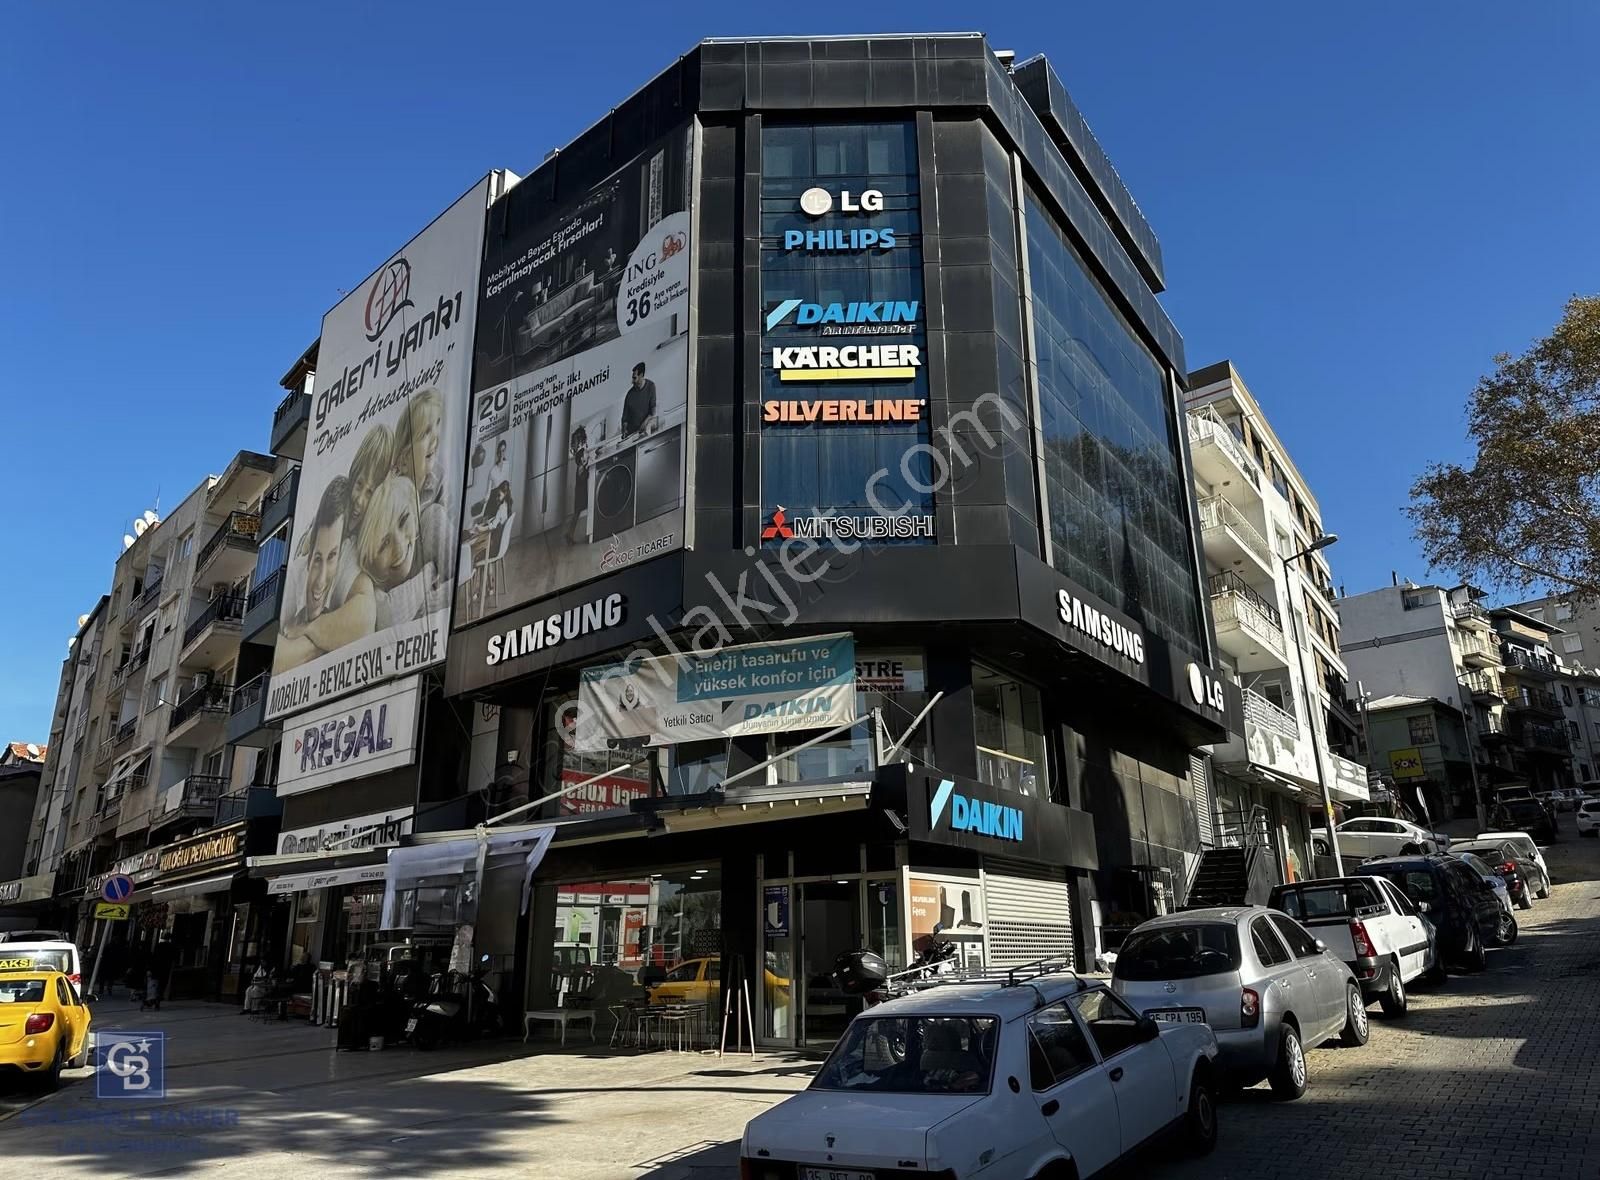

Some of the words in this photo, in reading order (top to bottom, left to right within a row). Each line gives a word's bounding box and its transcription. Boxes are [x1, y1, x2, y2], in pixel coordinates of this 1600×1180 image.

[841, 189, 884, 212] LG
[784, 227, 897, 250] PHILIPS
[486, 262, 517, 286] Mobilya
[517, 255, 527, 264] ve
[527, 239, 551, 259] Beyaz
[627, 252, 657, 284] ING
[626, 269, 665, 299] Kredisiyle
[625, 290, 651, 327] 36
[796, 301, 919, 325] DAIKIN
[772, 344, 922, 369] KÄRCHER
[480, 387, 509, 421] 20
[513, 389, 550, 414] Dünyada
[552, 380, 565, 394] bir
[566, 370, 581, 387] ilk!
[512, 416, 521, 428] 20
[536, 394, 565, 415] MOTOR
[763, 399, 920, 422] SILVERLINE
[793, 515, 936, 538] MITSUBISHI
[486, 593, 623, 666] SAMSUNG
[1058, 588, 1144, 664] SAMSUNG
[268, 676, 311, 715] MOBİLYA
[318, 658, 353, 697] BEYAZ
[354, 646, 383, 687] EŞYA
[395, 628, 439, 671] PERDE
[695, 656, 737, 674] Enerji
[741, 648, 807, 669] tasarufu
[811, 647, 830, 660] ve
[694, 675, 747, 696] yüksek
[751, 669, 803, 687] konfor
[808, 665, 837, 683] için
[1205, 674, 1225, 712] LG
[663, 715, 688, 728] Yetkili
[689, 713, 714, 725] Satıcı
[743, 695, 833, 720] DAIKIN
[300, 703, 393, 773] REGAL
[951, 793, 1023, 841] DAIKIN
[1186, 1012, 1202, 1024] 195
